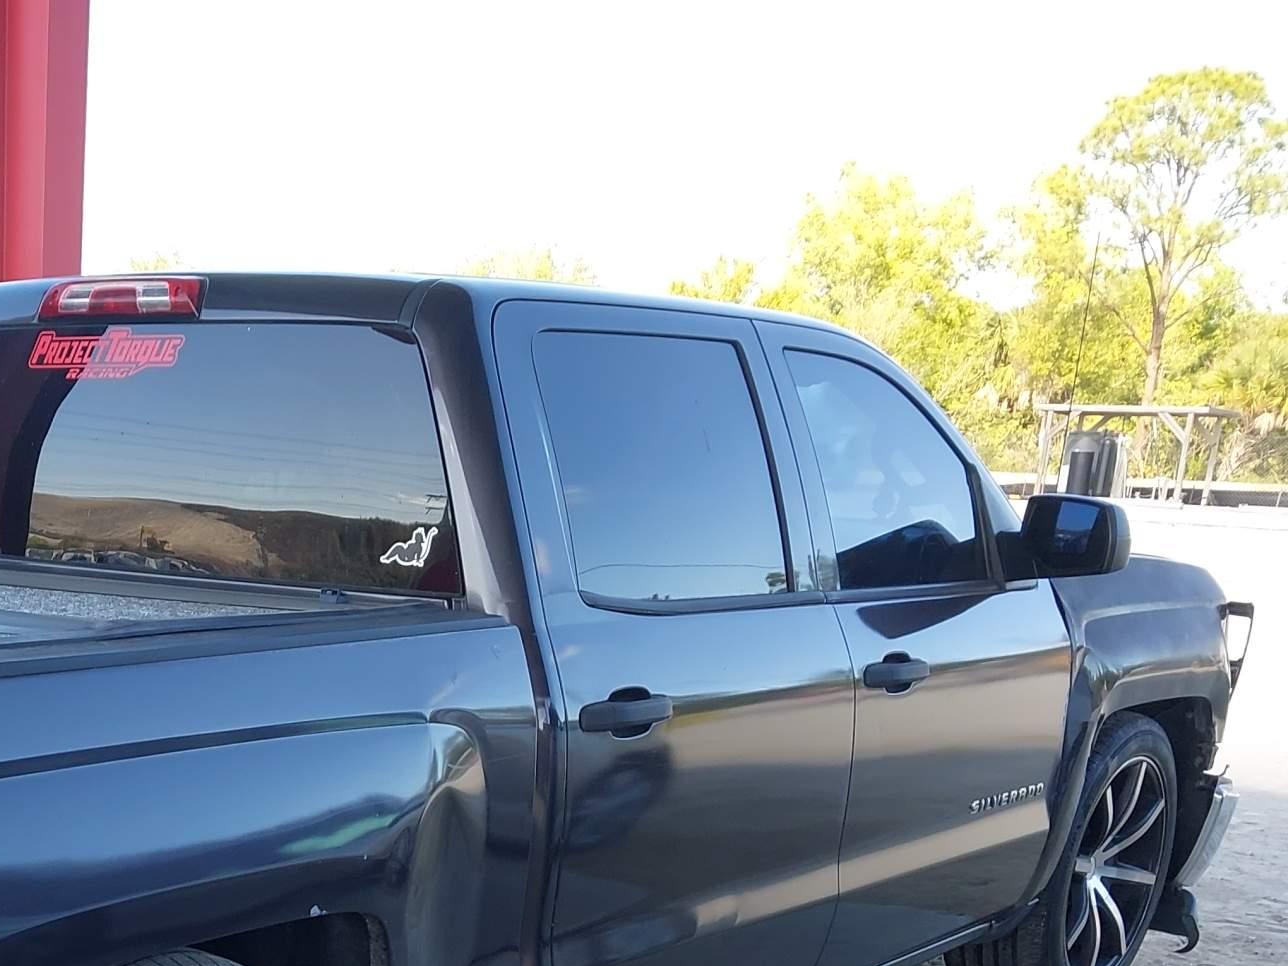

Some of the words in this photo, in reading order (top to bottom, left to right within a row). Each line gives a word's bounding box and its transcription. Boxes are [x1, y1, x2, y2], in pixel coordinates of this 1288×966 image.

[30, 332, 105, 365] PROJECT
[105, 330, 183, 364] TORQUE
[65, 366, 132, 379] RACING
[970, 782, 1045, 815] SILVERADO
